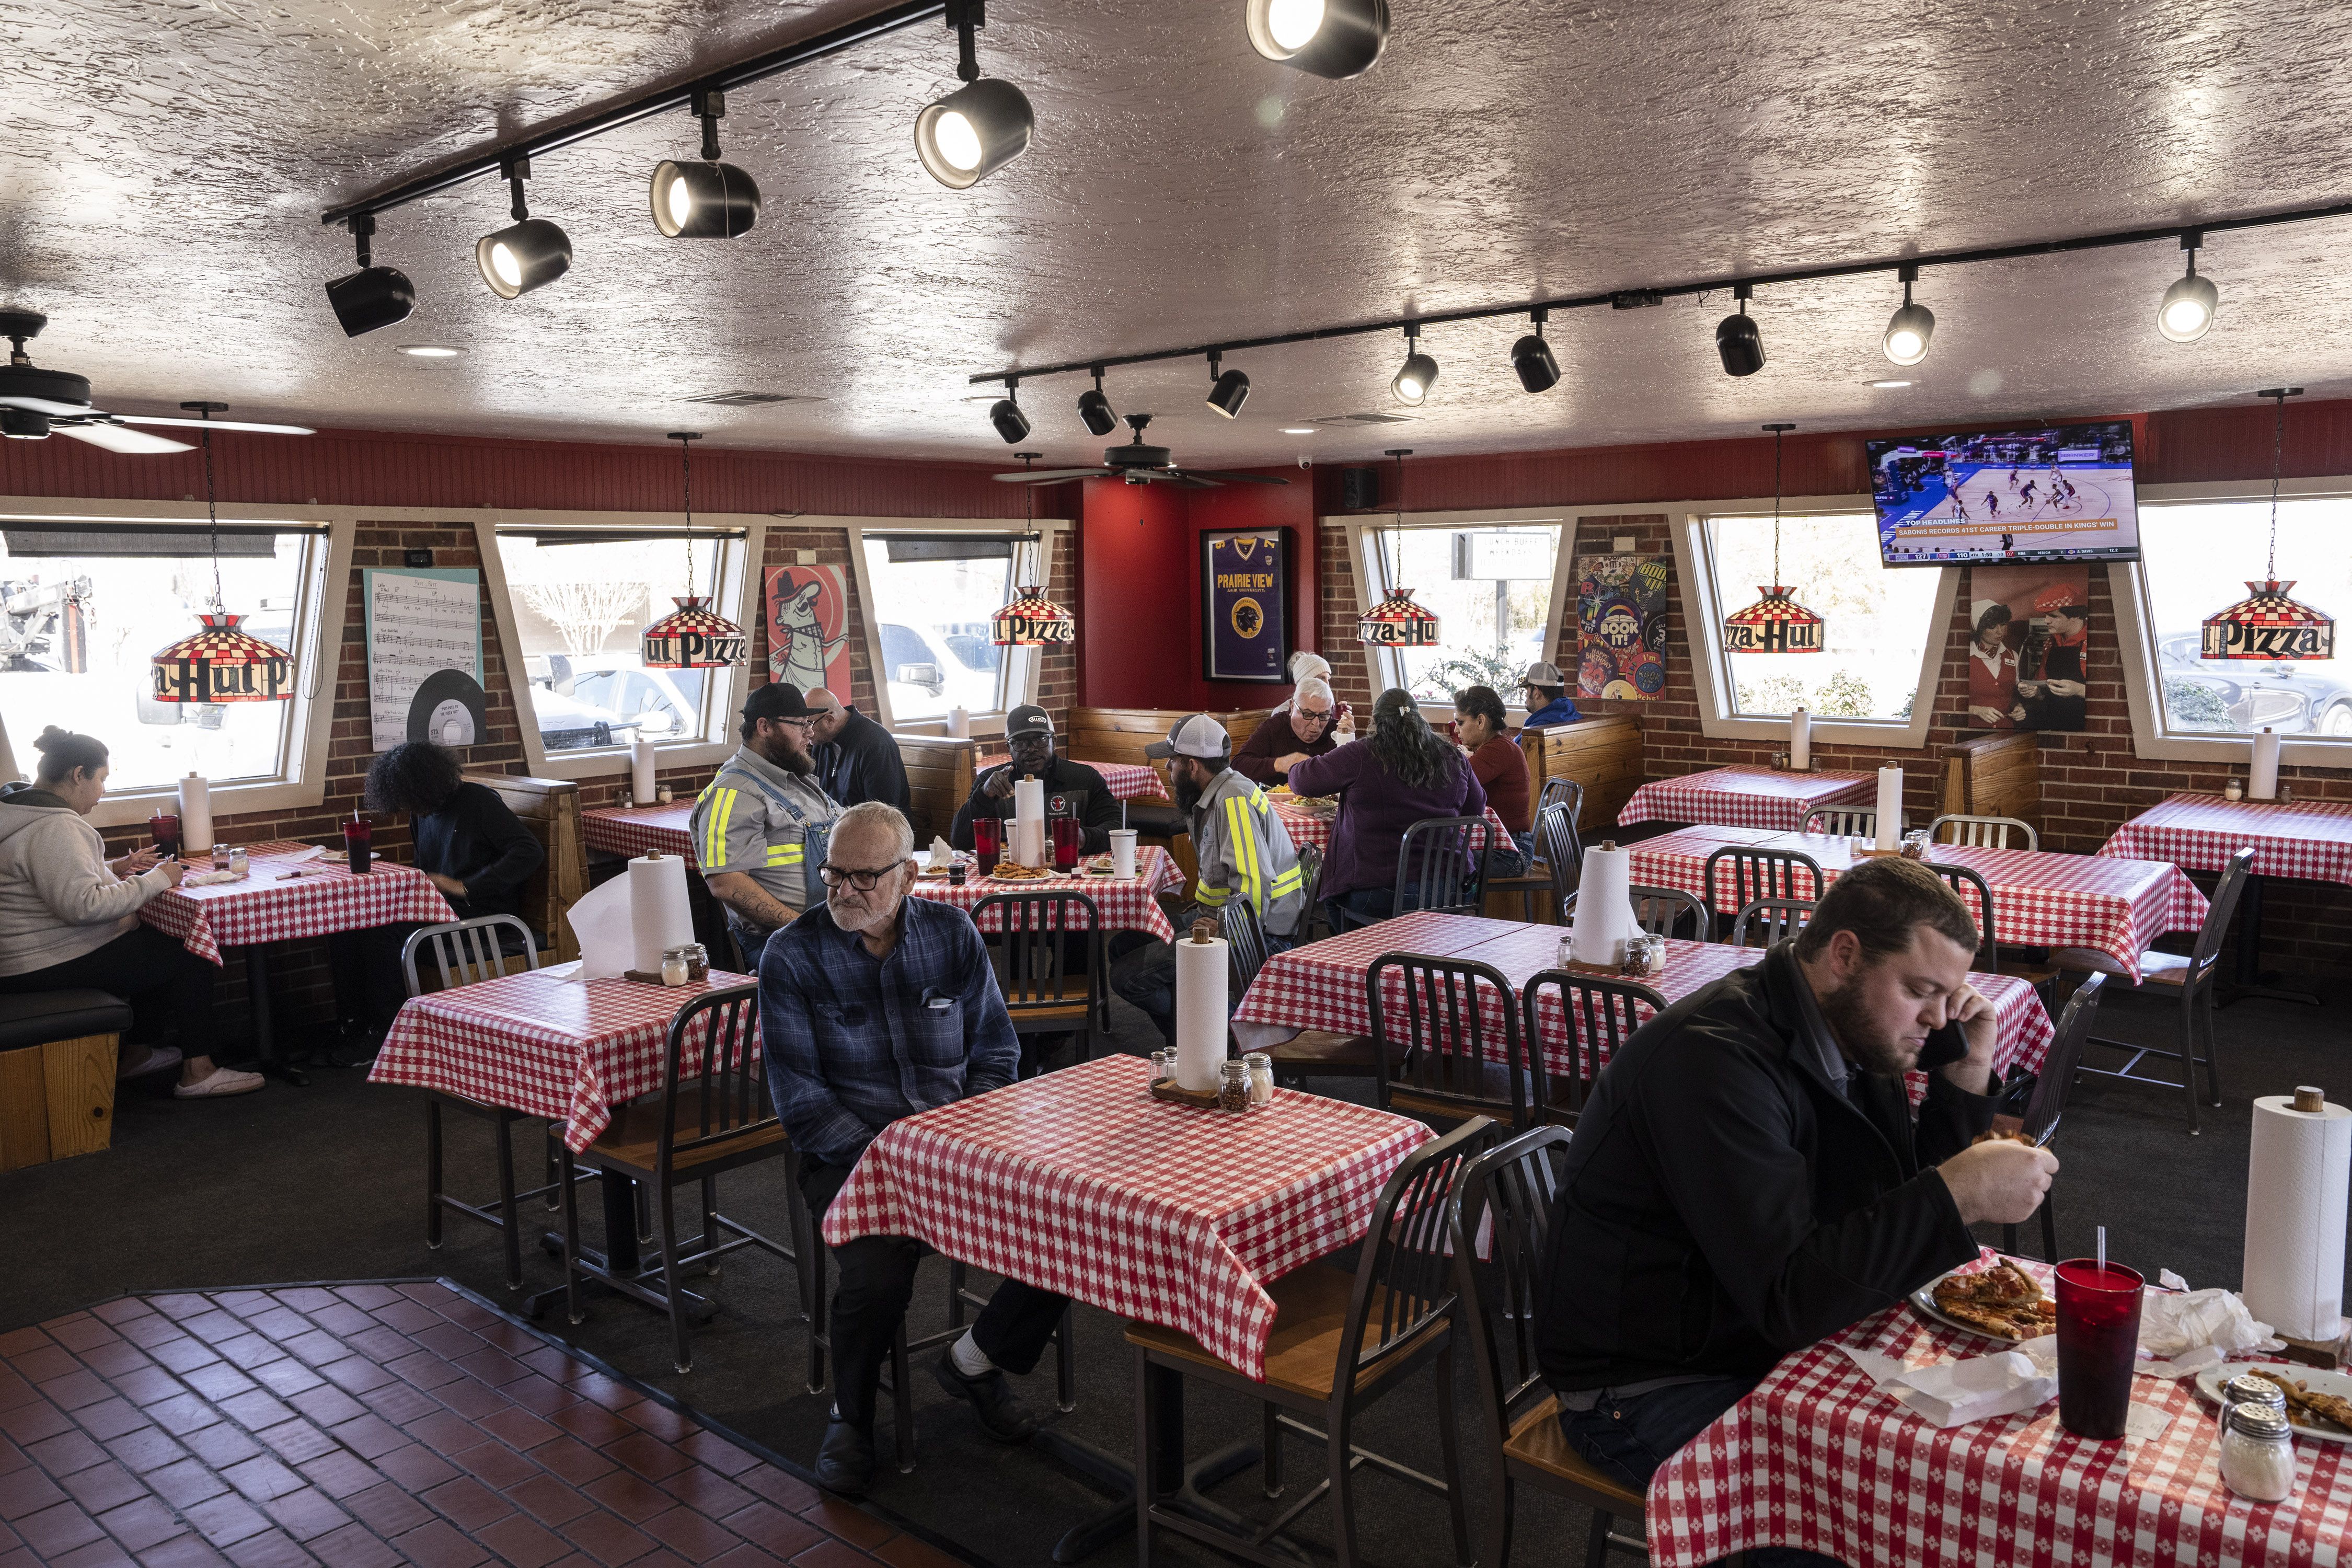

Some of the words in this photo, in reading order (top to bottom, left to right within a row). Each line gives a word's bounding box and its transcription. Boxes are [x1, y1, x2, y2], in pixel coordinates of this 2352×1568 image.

[1640, 563, 1666, 581] BOO
[1218, 573, 1251, 589] PRAIRIE
[1252, 573, 1273, 588] VIEW
[1646, 578, 1664, 591] IT!
[1009, 615, 1071, 645] Pizza
[1600, 622, 1639, 635] BOOK
[1655, 629, 1666, 642] 3
[647, 634, 671, 661] ut
[1611, 634, 1628, 645] IT!
[2220, 620, 2323, 659] Pizza
[1586, 652, 1613, 669] BIRTHDAY
[1592, 648, 1609, 659] HAPPY
[1582, 662, 1605, 684] 20
